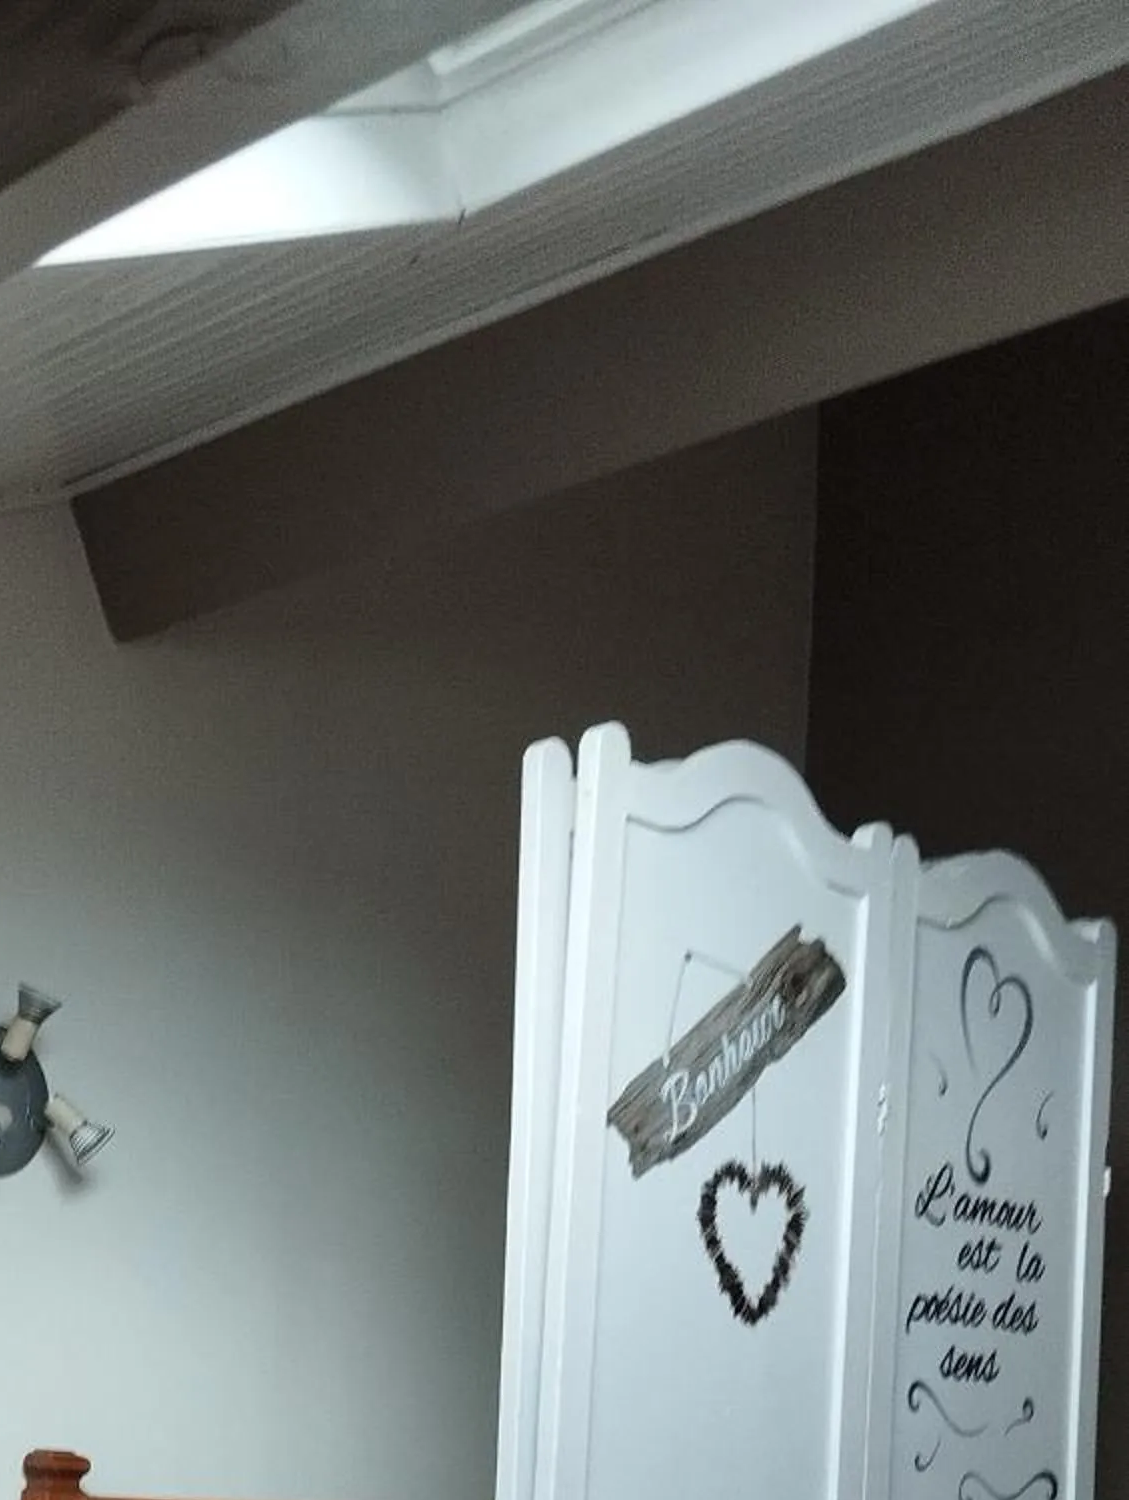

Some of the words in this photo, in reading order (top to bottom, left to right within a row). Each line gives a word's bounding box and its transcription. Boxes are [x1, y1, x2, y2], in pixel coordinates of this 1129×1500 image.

[914, 1161, 1043, 1235] L'amour
[957, 1236, 1001, 1273] est
[1016, 1240, 1046, 1283] la
[905, 1284, 987, 1335] poésie
[992, 1290, 1039, 1336] des
[939, 1344, 1001, 1383] sens
